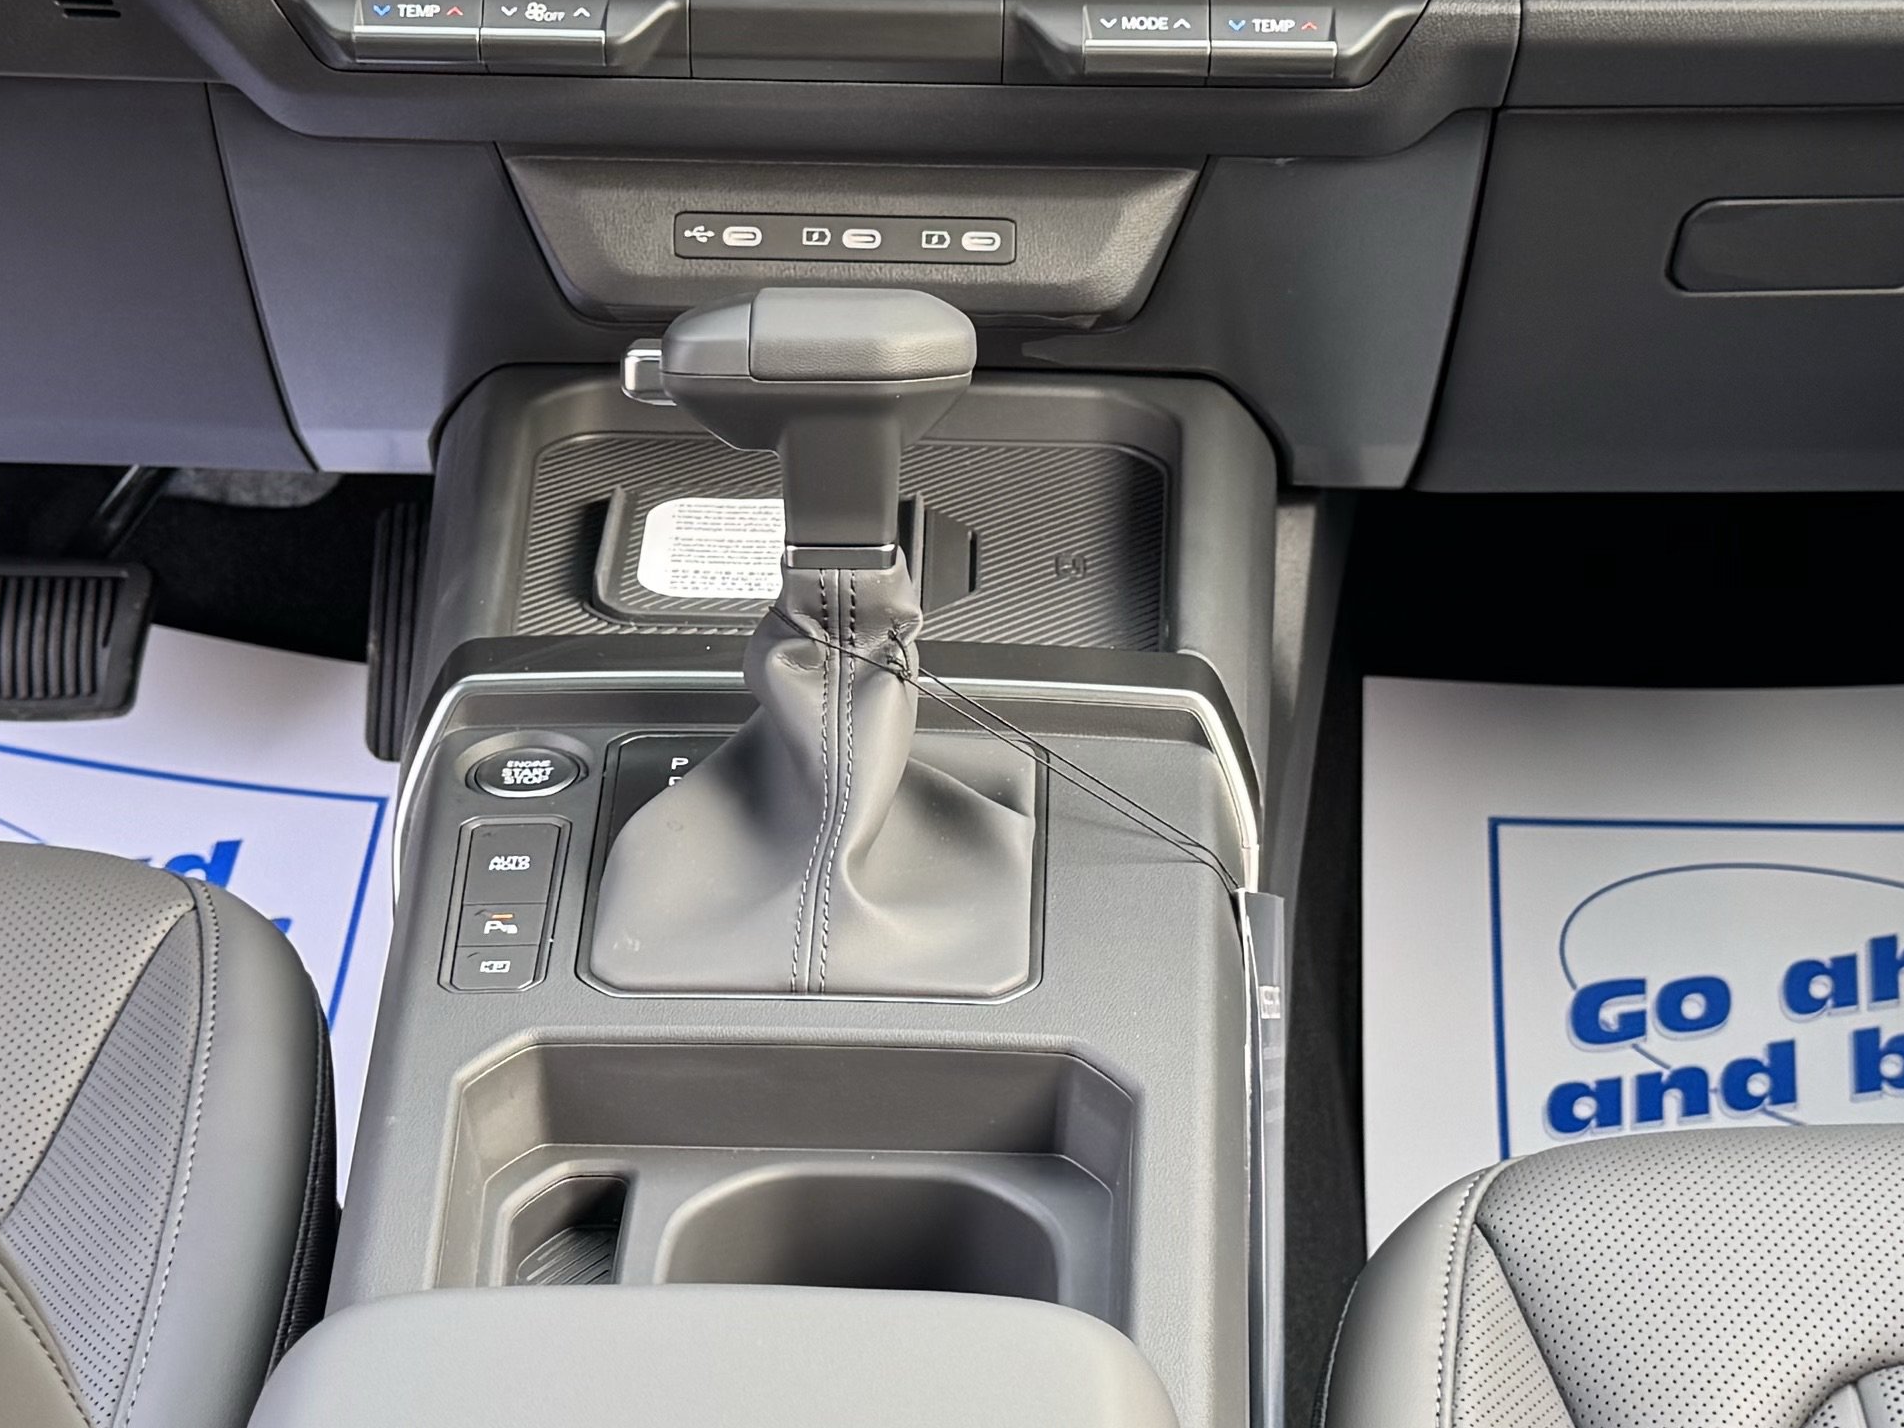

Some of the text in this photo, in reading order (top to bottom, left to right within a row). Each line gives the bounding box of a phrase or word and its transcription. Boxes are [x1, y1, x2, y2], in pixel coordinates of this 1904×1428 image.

[397, 3, 441, 18] TEMP
[546, 11, 566, 22] OFF
[1121, 16, 1169, 31] MODE
[1252, 18, 1296, 33] TEMP
[506, 760, 551, 768] ENGINE
[671, 757, 689, 770] P
[501, 767, 555, 778] START
[503, 775, 549, 785] STOP
[490, 856, 531, 865] AUTO
[1569, 974, 1732, 1046] Go
[1544, 1038, 1798, 1135] and
